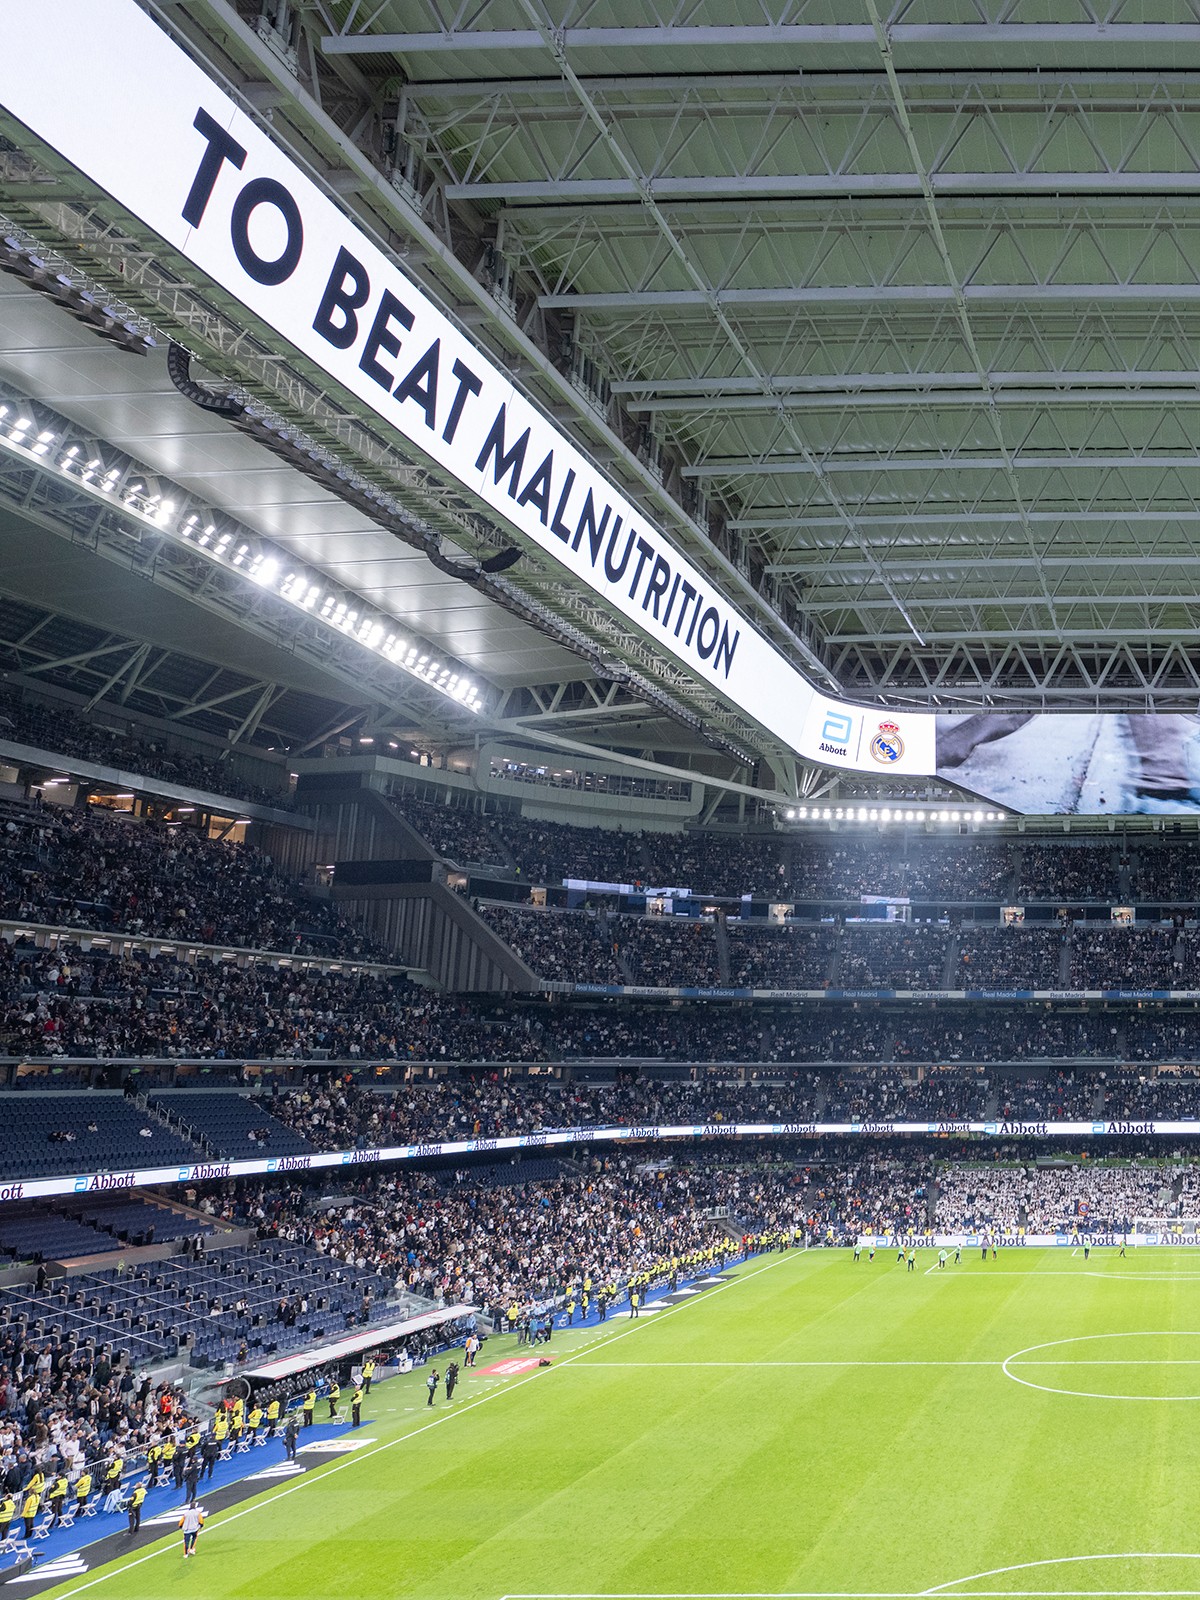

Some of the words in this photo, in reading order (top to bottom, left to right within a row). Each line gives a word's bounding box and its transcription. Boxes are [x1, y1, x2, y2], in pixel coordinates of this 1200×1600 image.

[181, 106, 304, 286] TO
[312, 245, 483, 446] BEAT
[474, 402, 740, 680] MALNUTRITION
[818, 742, 847, 756] Abbott
[629, 1128, 660, 1137] Abbott
[703, 1125, 737, 1134] Abbott
[782, 1124, 817, 1133] Abbott
[862, 1124, 894, 1132] Abbott
[938, 1123, 971, 1132] Abbott
[1000, 1123, 1048, 1134] Abbott
[1107, 1122, 1155, 1134] Abbott
[526, 1134, 546, 1145] Abbott
[572, 1130, 594, 1141] Abbott
[474, 1139, 497, 1150] Abbott
[351, 1150, 380, 1162] Abbott
[416, 1144, 442, 1157] Abbott
[277, 1156, 311, 1171] Abbott
[191, 1163, 230, 1178] Abbott
[90, 1174, 135, 1190] Abbott
[890, 1236, 936, 1247] Abbott
